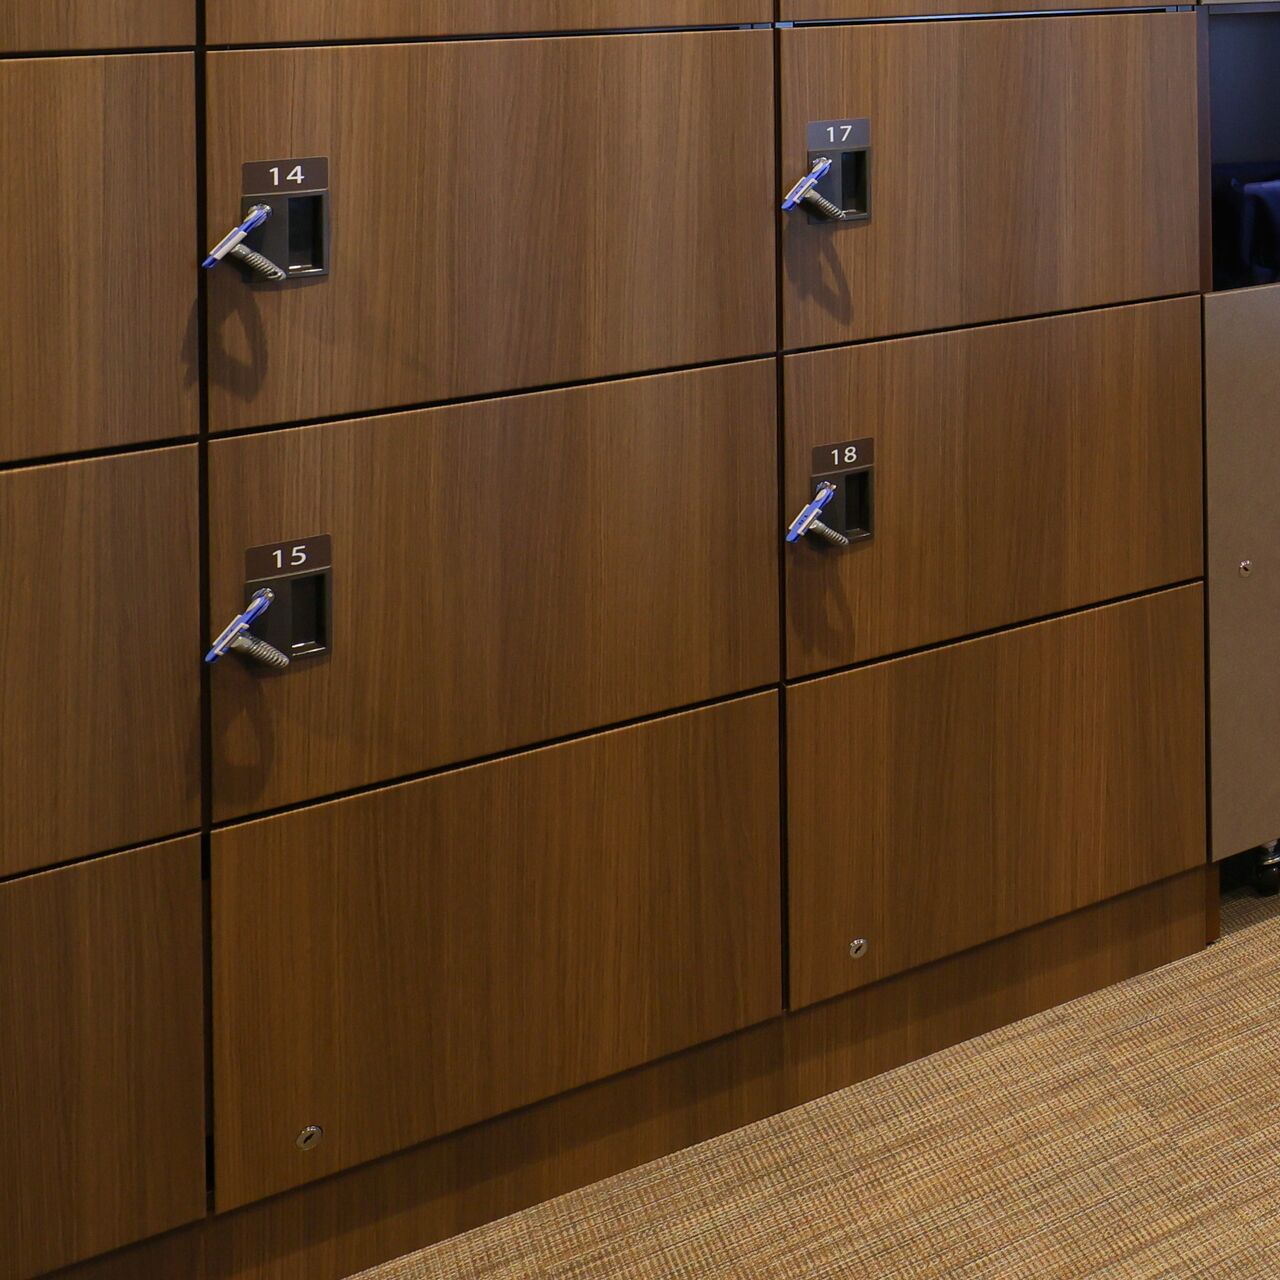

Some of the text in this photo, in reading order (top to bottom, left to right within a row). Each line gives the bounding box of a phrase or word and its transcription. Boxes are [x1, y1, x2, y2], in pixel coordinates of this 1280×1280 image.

[826, 125, 852, 143] 17
[269, 165, 305, 186] 14
[831, 446, 857, 465] 18
[272, 545, 307, 569] 15
